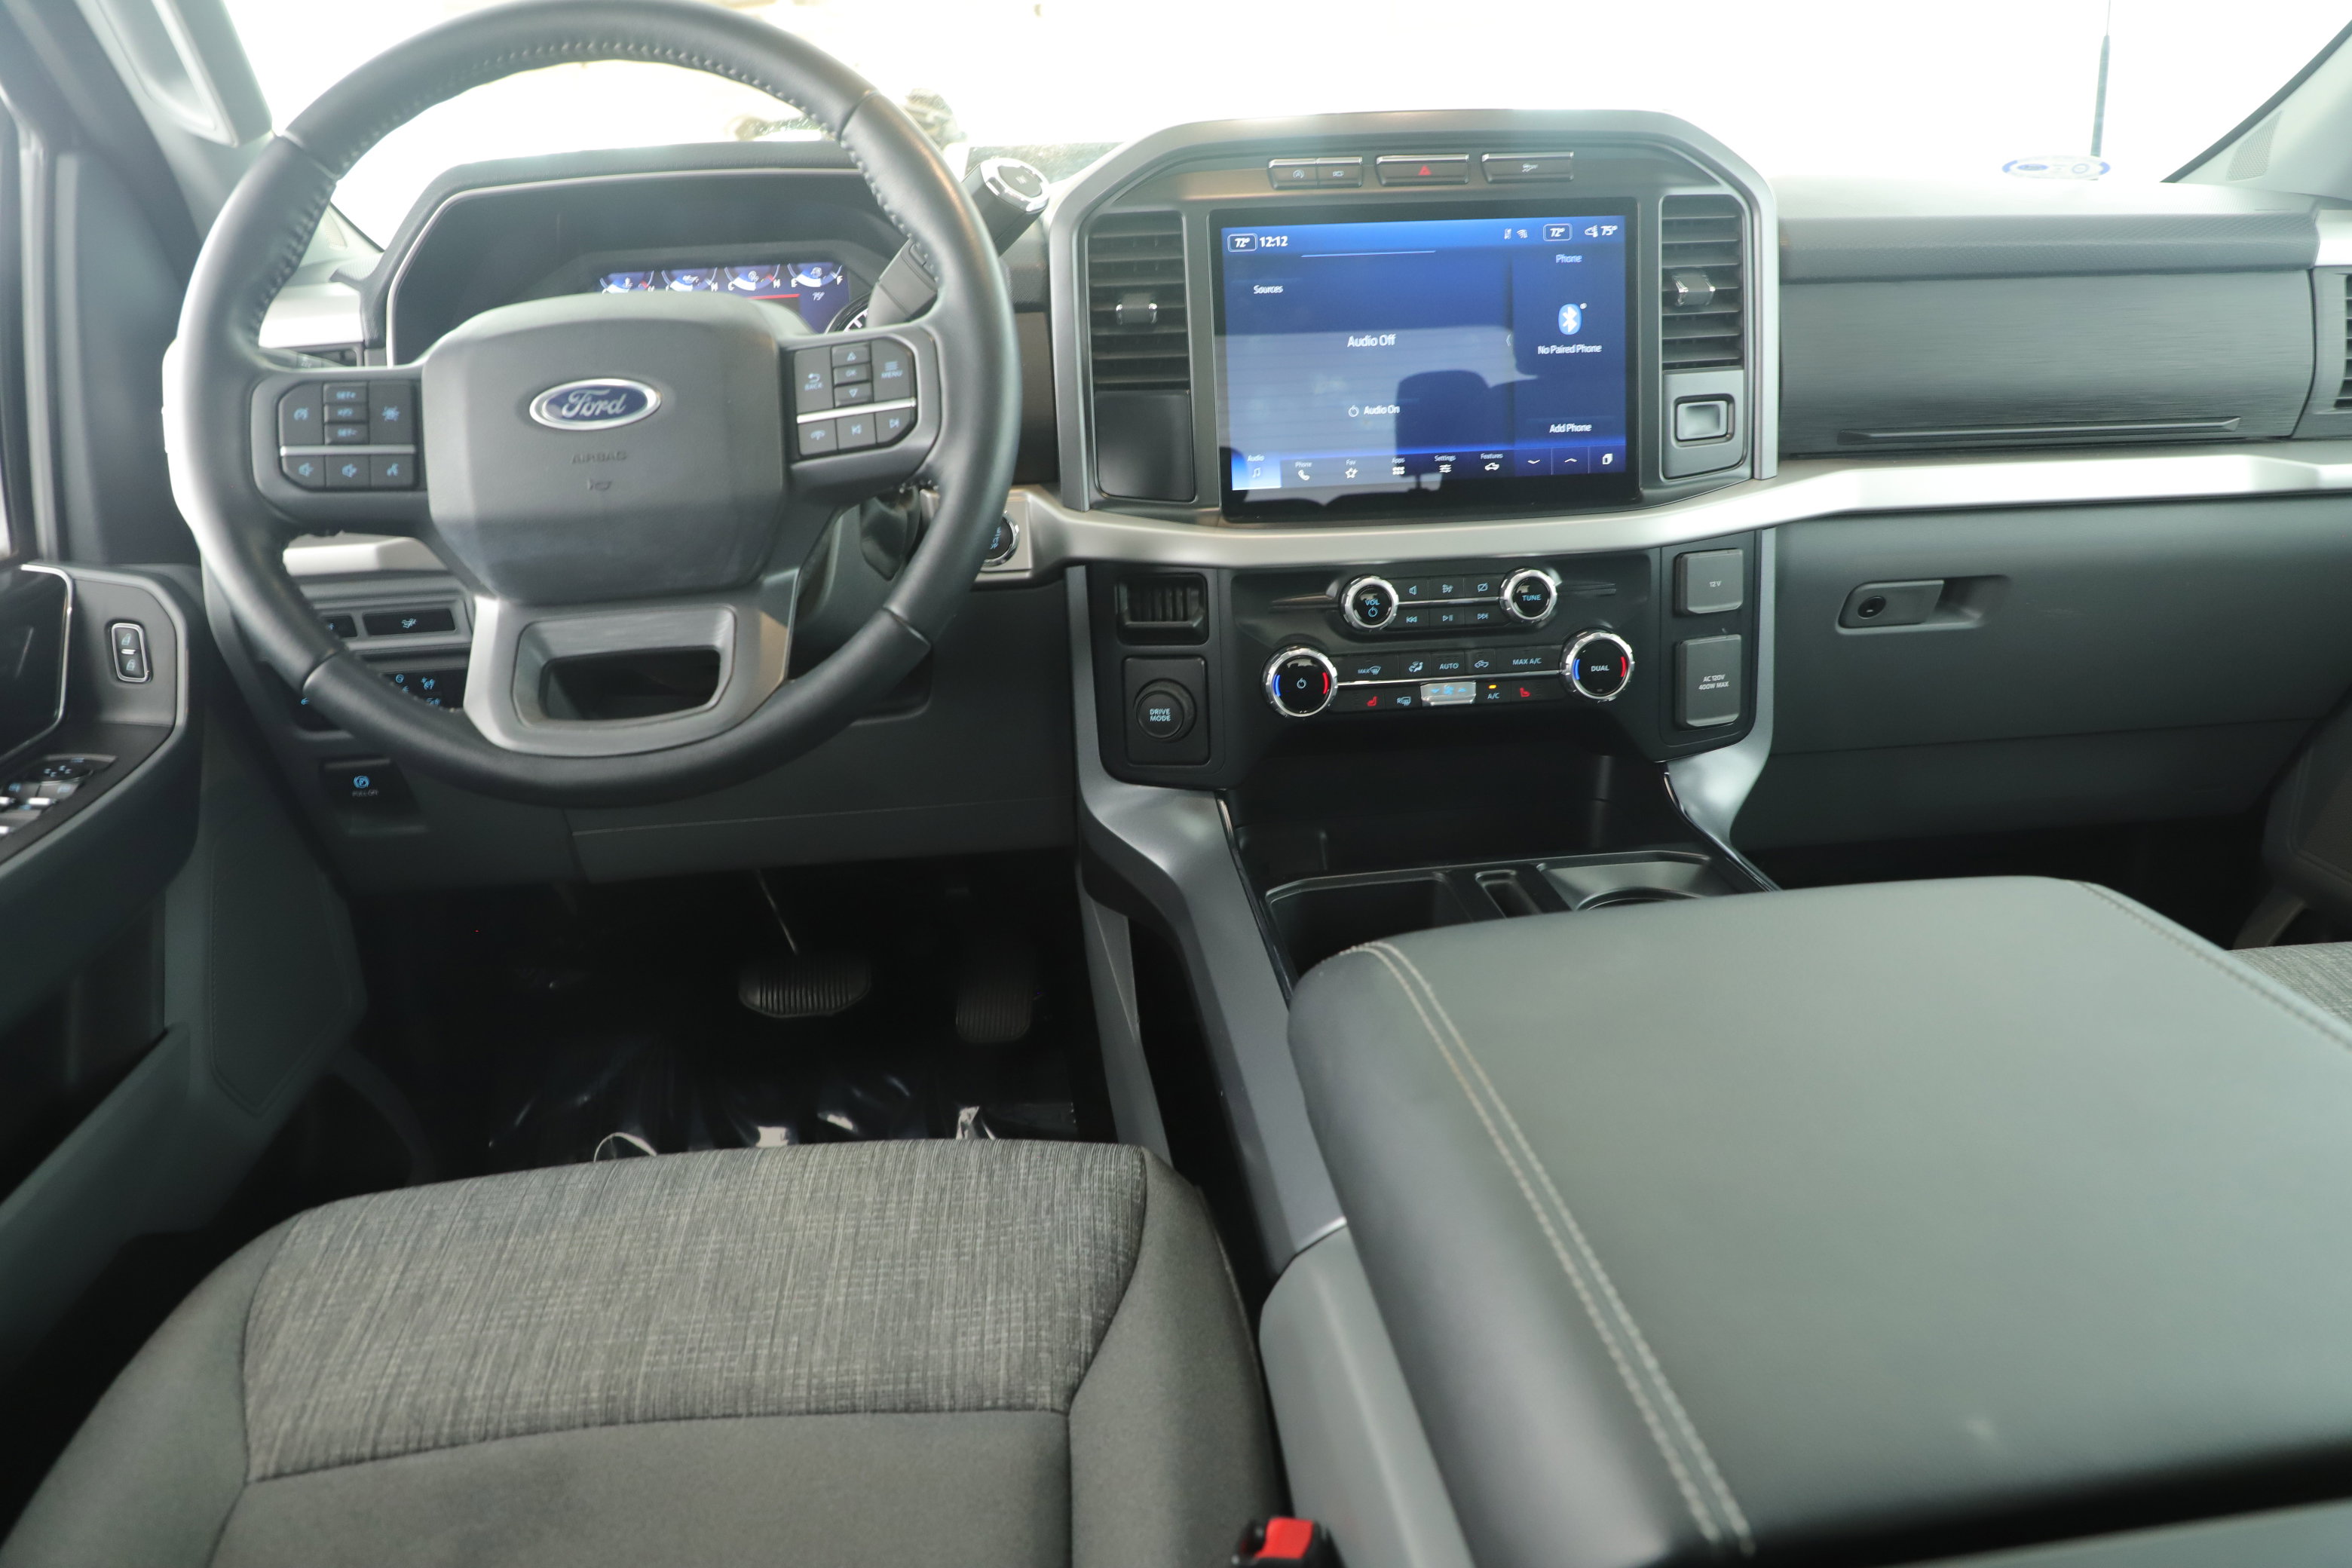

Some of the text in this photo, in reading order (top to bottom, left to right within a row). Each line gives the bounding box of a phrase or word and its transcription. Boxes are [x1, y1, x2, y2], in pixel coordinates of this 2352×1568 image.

[1259, 235, 1288, 247] 12:12
[1555, 253, 1582, 264] Phone
[1253, 284, 1284, 295] Sources
[1346, 333, 1397, 348] Audio Off
[1537, 343, 1603, 355] No Paired Phone
[804, 382, 823, 391] BACK
[561, 388, 627, 418] Ford
[1363, 404, 1401, 415] Audio On
[1548, 422, 1592, 433] Add Phone
[1247, 454, 1265, 462] Audio
[1346, 458, 1356, 467] Fav
[1391, 457, 1405, 465] Apps
[1521, 593, 1542, 602] TUNE
[1439, 662, 1459, 670] AUTO
